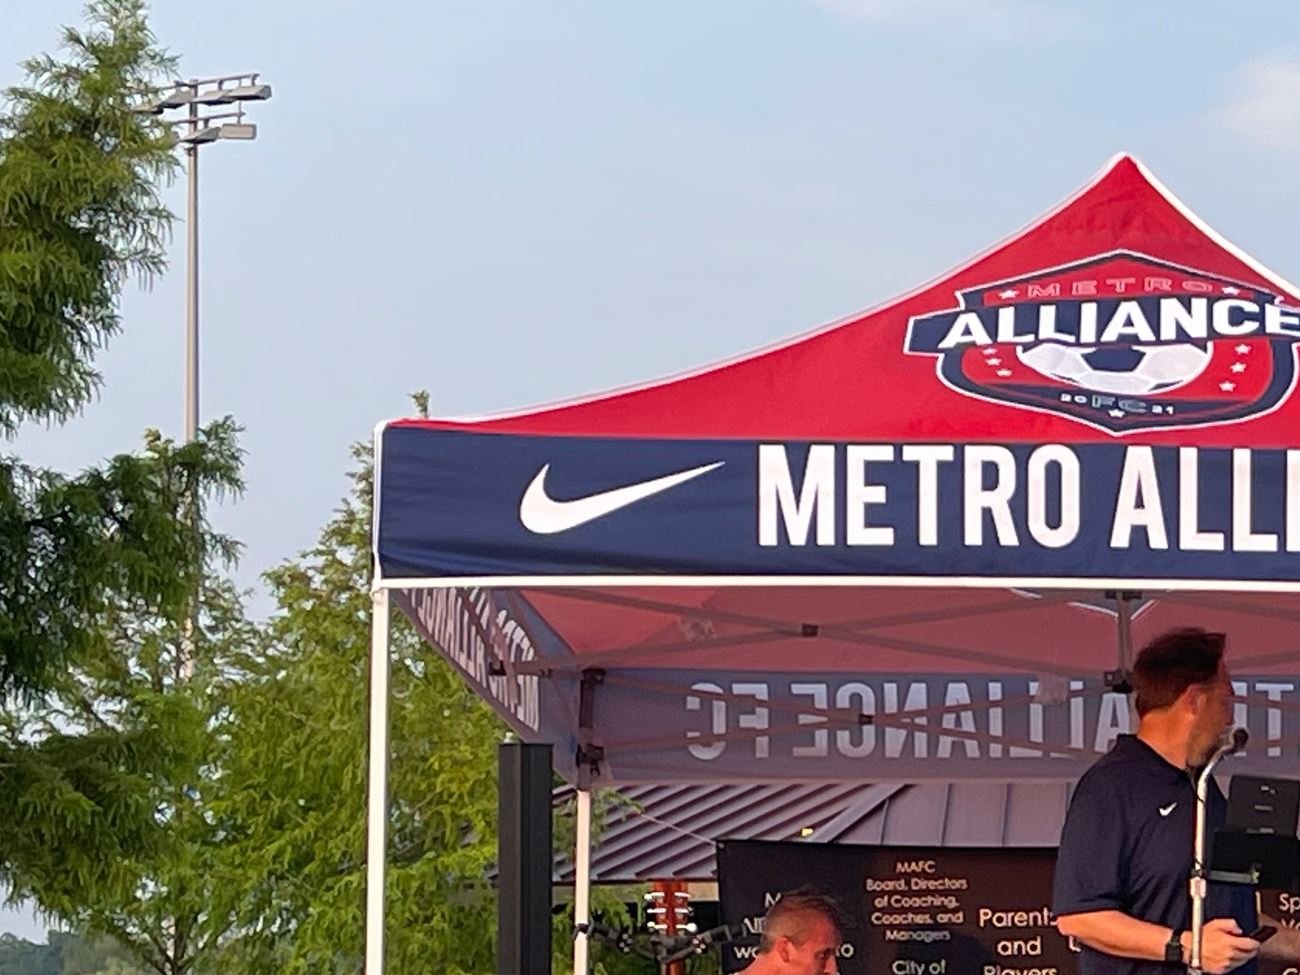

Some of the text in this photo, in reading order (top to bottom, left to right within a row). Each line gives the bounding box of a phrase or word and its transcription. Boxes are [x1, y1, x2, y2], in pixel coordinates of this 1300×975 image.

[1027, 276, 1213, 298] METRO
[1091, 394, 1148, 413] FC
[757, 443, 1080, 548] METRO
[896, 860, 936, 873] MAFC
[911, 877, 967, 890] Directors
[874, 895, 888, 908] of
[936, 910, 964, 923] and
[885, 929, 951, 943] Managers
[997, 936, 1041, 956] and
[929, 958, 946, 975] of
